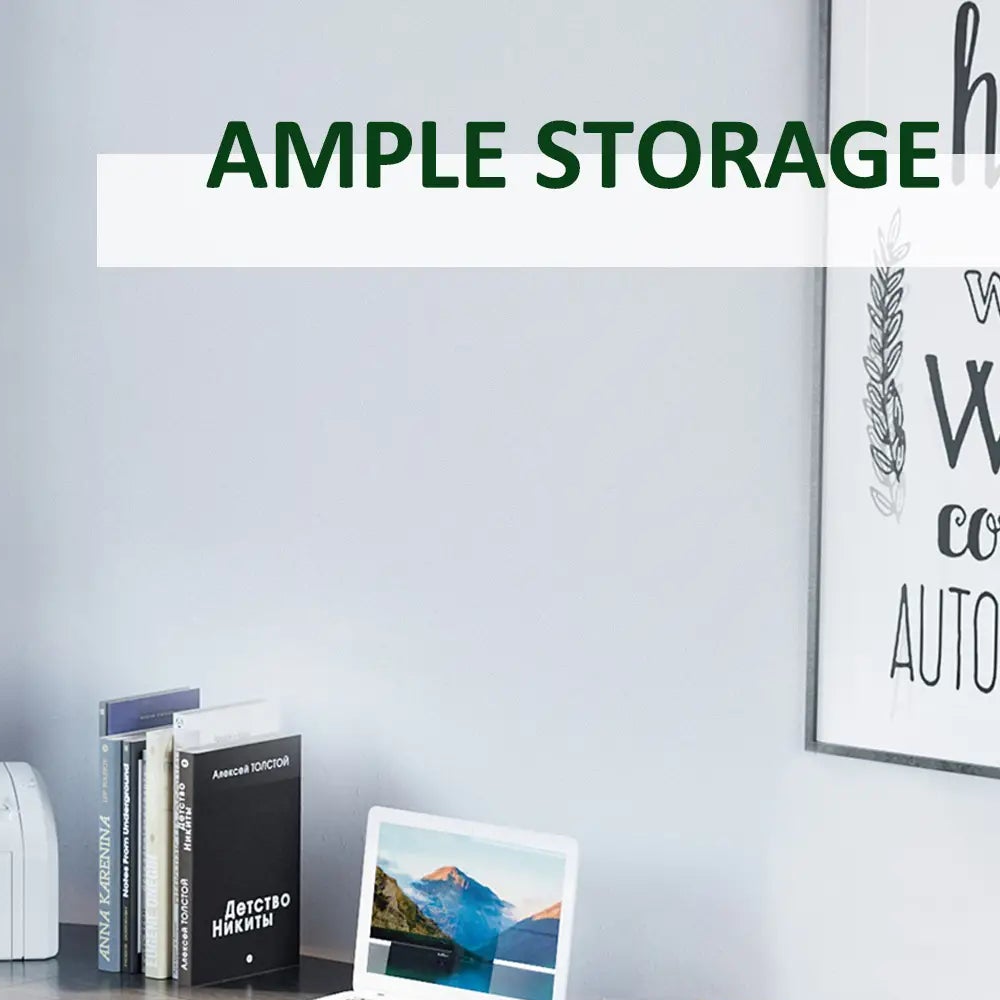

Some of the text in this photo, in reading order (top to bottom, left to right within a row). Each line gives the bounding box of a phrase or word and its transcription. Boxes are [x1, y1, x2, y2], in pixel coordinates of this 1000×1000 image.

[891, 584, 999, 693] AUTO
[212, 755, 290, 780] Алексей ТОЛСТОЙ
[122, 763, 130, 833] Underground
[99, 815, 112, 906] KARENINA
[122, 834, 130, 865] From
[122, 866, 130, 898] Notes
[180, 878, 189, 971] Алексей ТОЛСТОЙ
[212, 912, 273, 938] Никиты
[225, 893, 291, 920] Детство
[99, 909, 111, 963] ANNA
